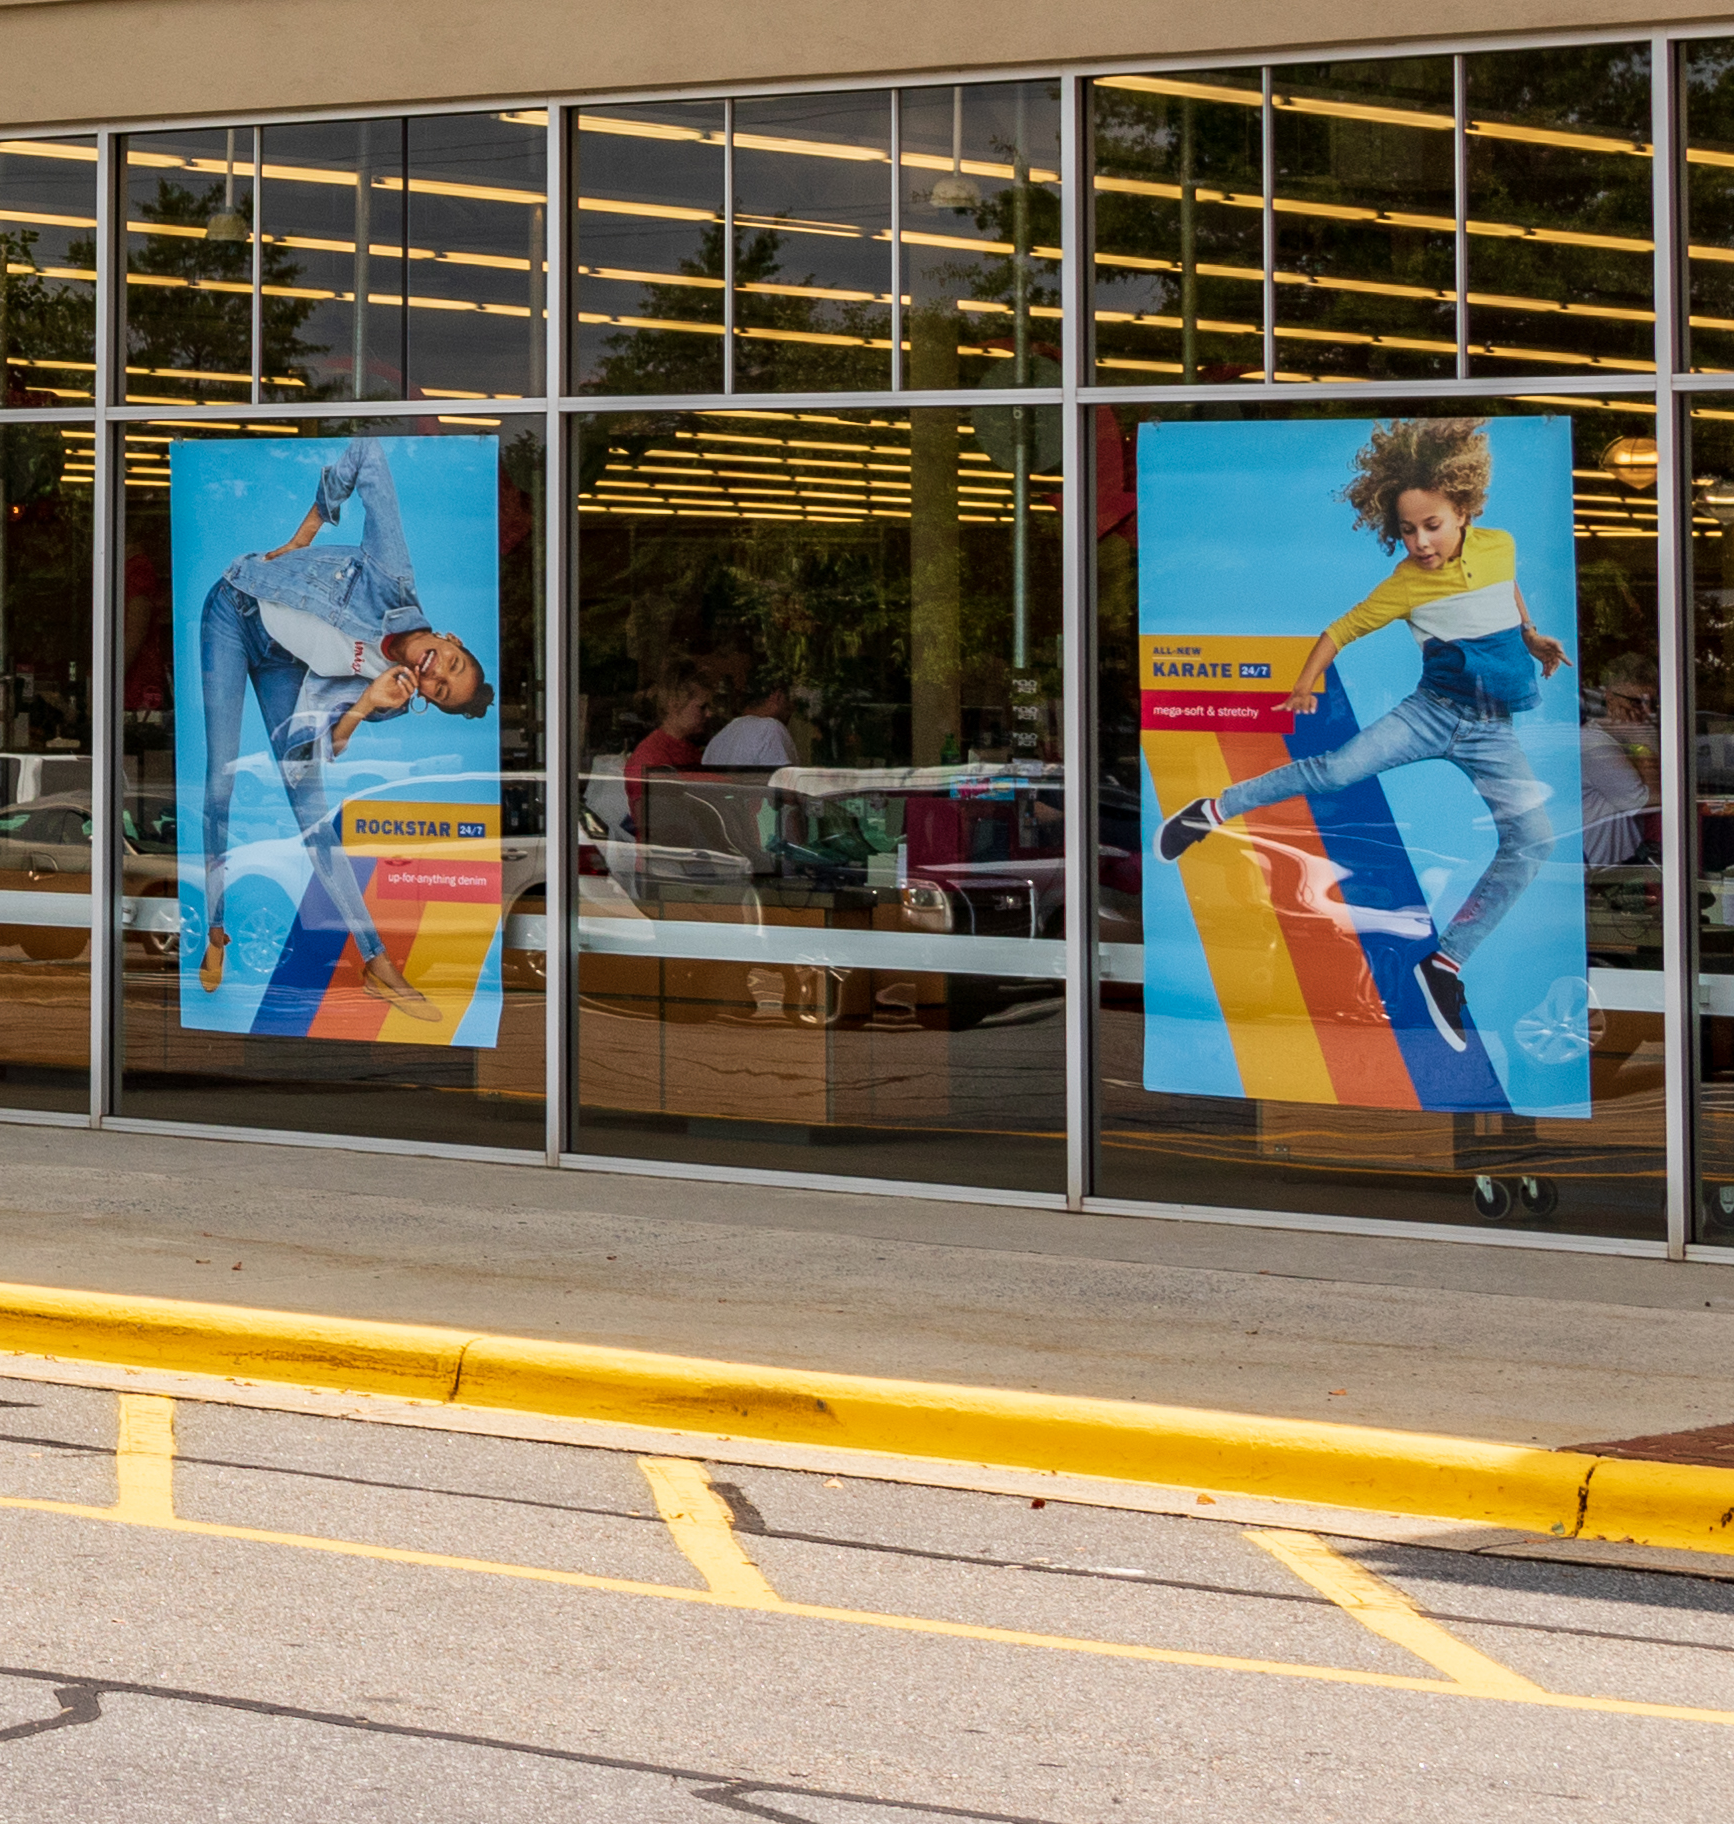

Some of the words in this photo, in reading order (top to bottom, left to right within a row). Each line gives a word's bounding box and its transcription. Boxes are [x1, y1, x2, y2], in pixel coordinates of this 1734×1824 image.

[1153, 662, 1232, 678] KARATE
[1241, 666, 1268, 676] 24/7
[1153, 706, 1204, 718] mega-soft
[1207, 706, 1215, 717] &
[1217, 707, 1259, 719] stretchy
[355, 819, 451, 837] ROCKSTAR
[459, 826, 483, 836] 24/7
[388, 873, 456, 887] up-for-anything
[458, 875, 487, 886] denim
